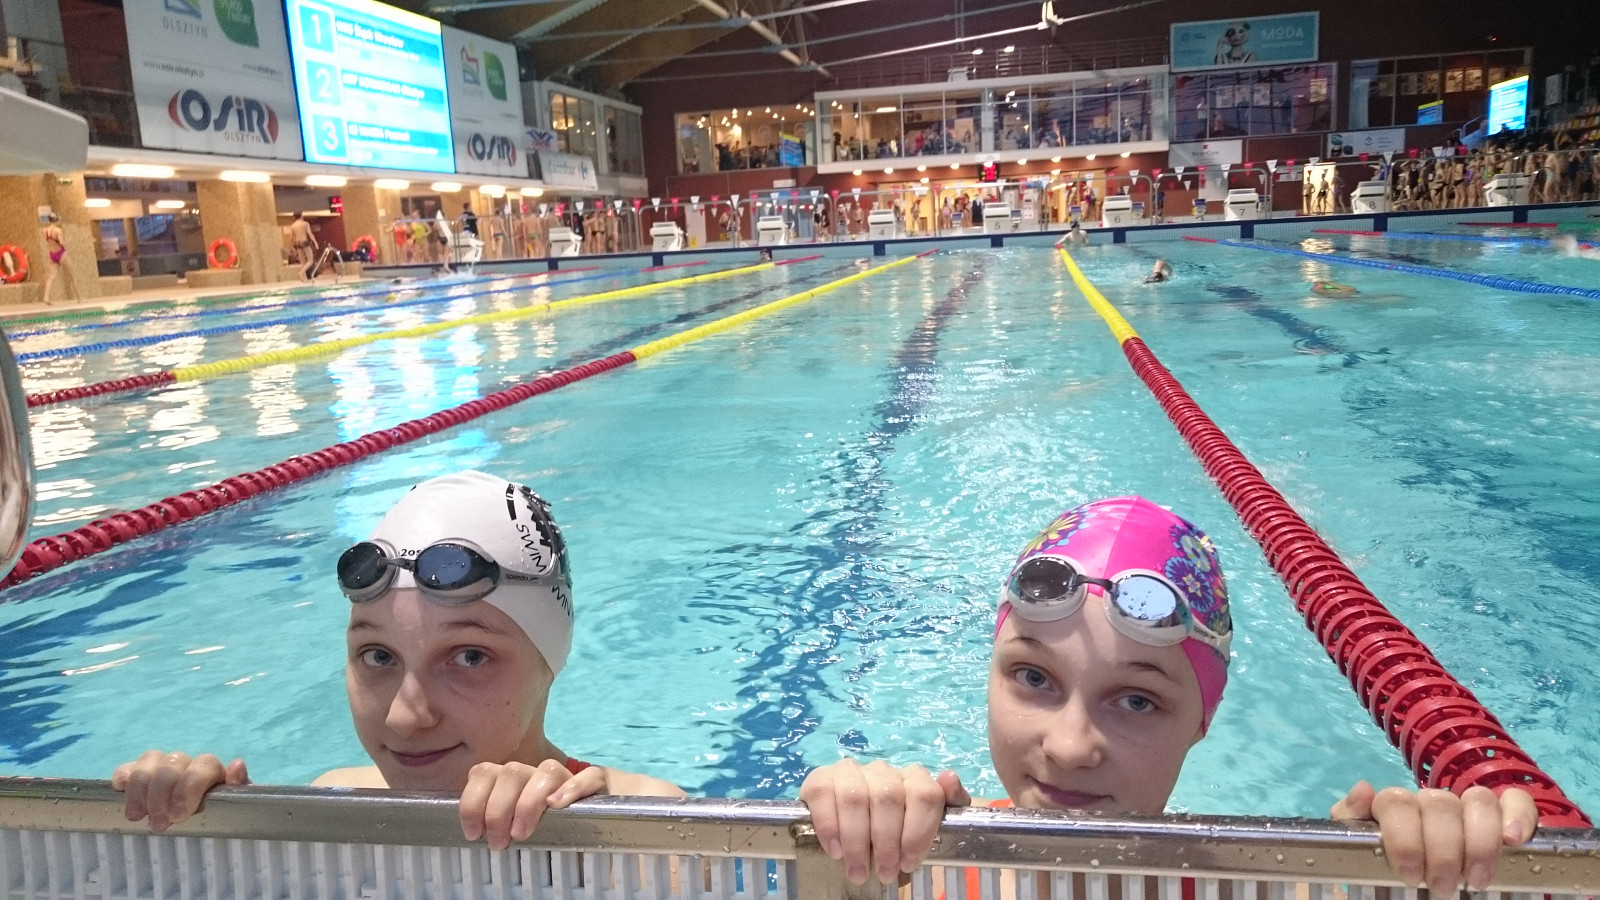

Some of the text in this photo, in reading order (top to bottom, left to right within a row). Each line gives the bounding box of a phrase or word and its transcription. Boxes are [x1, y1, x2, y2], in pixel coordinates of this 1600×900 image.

[162, 15, 208, 39] OLSZTYN
[316, 67, 333, 99] 2
[223, 131, 261, 144] OLSZTYN
[322, 120, 339, 151] 3
[1369, 200, 1377, 210] 8
[1239, 208, 1246, 217] 7
[1114, 215, 1121, 223] 6
[994, 223, 1001, 231] 5
[878, 228, 885, 236] 4
[768, 234, 775, 242] 3
[661, 240, 668, 248] 2
[516, 523, 547, 573] SWIM
